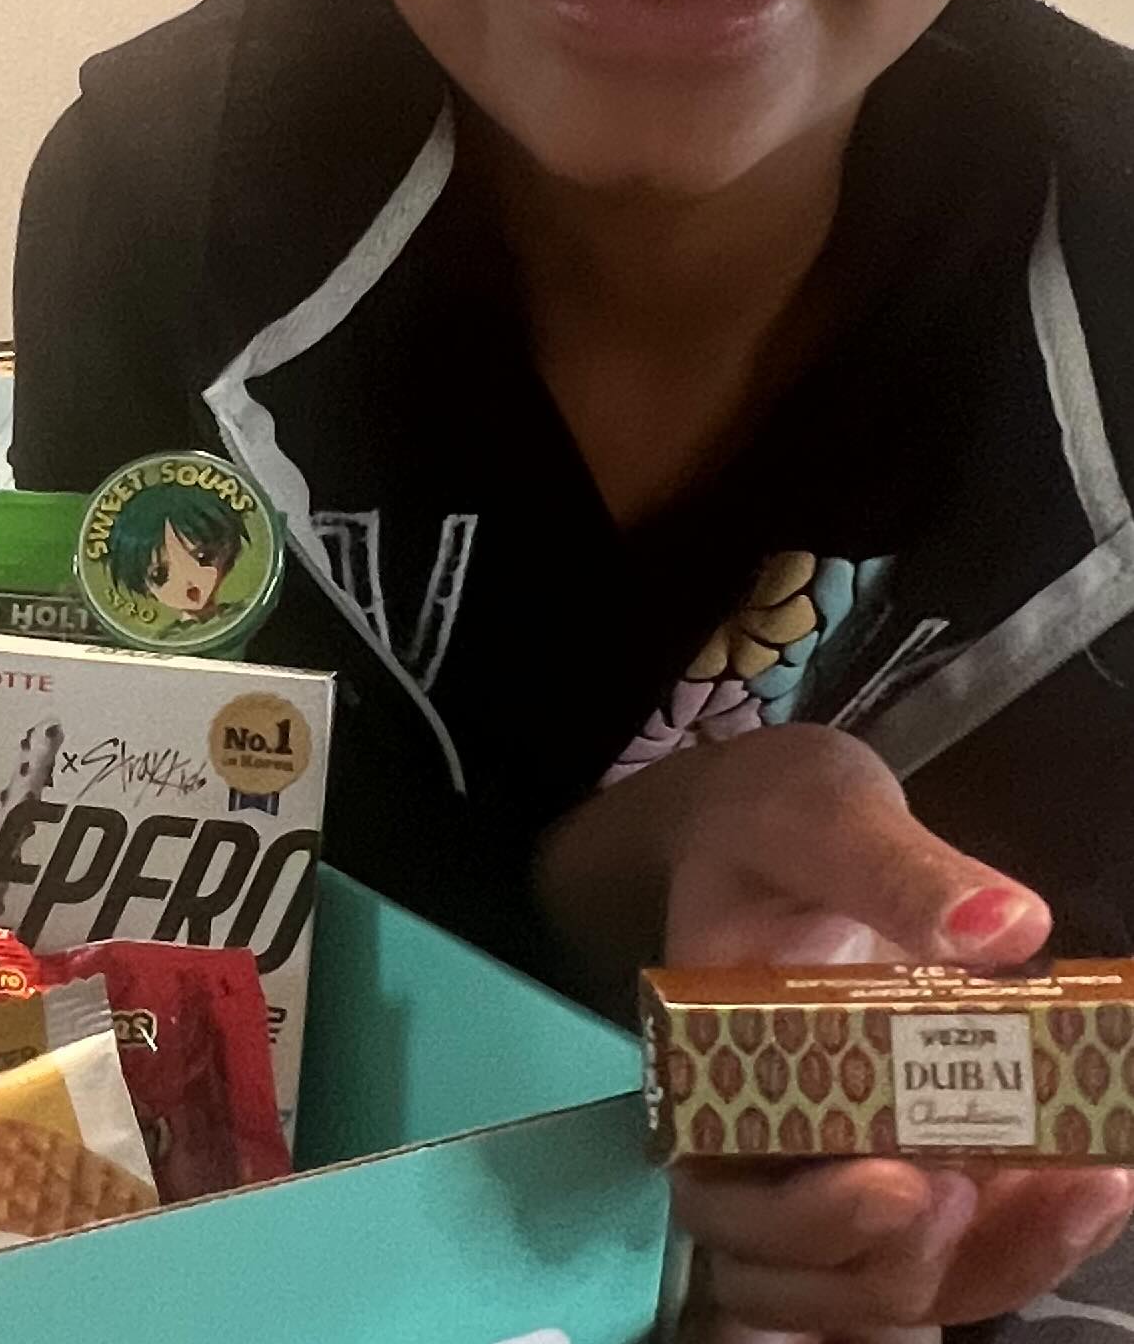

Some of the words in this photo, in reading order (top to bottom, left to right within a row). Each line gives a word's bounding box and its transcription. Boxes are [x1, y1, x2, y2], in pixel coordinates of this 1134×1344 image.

[86, 468, 147, 561] SWEET
[160, 461, 256, 513] SOURS
[10, 603, 106, 633] HOLT
[223, 718, 293, 755] No.1
[903, 1061, 1022, 1091] DUBAI
